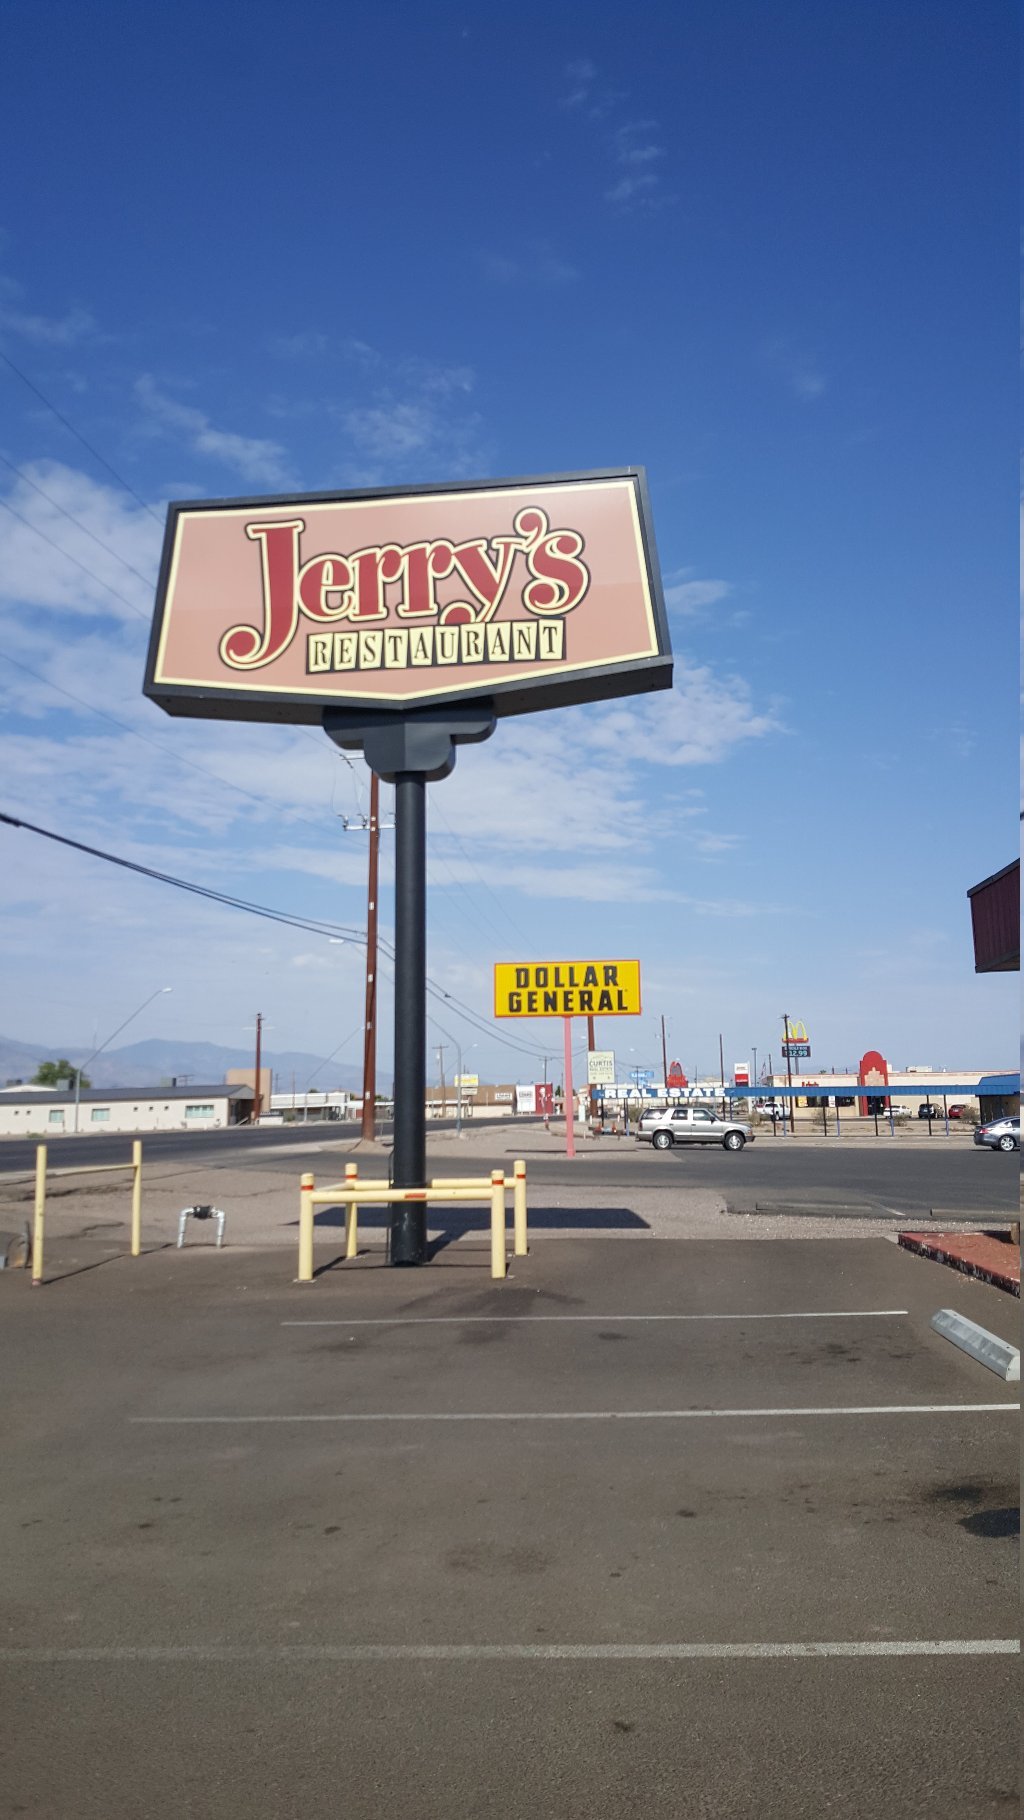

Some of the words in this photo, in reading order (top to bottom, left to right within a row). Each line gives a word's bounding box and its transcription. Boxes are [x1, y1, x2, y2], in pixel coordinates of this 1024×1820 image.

[219, 506, 591, 671] Jerry's
[312, 624, 561, 668] RESTAURANT
[516, 965, 619, 988] DOLLAR
[508, 990, 628, 1012] GENERAL
[589, 1060, 613, 1068] CURTIS
[604, 1089, 652, 1099] REAL
[657, 1087, 726, 1098] ESTATE
